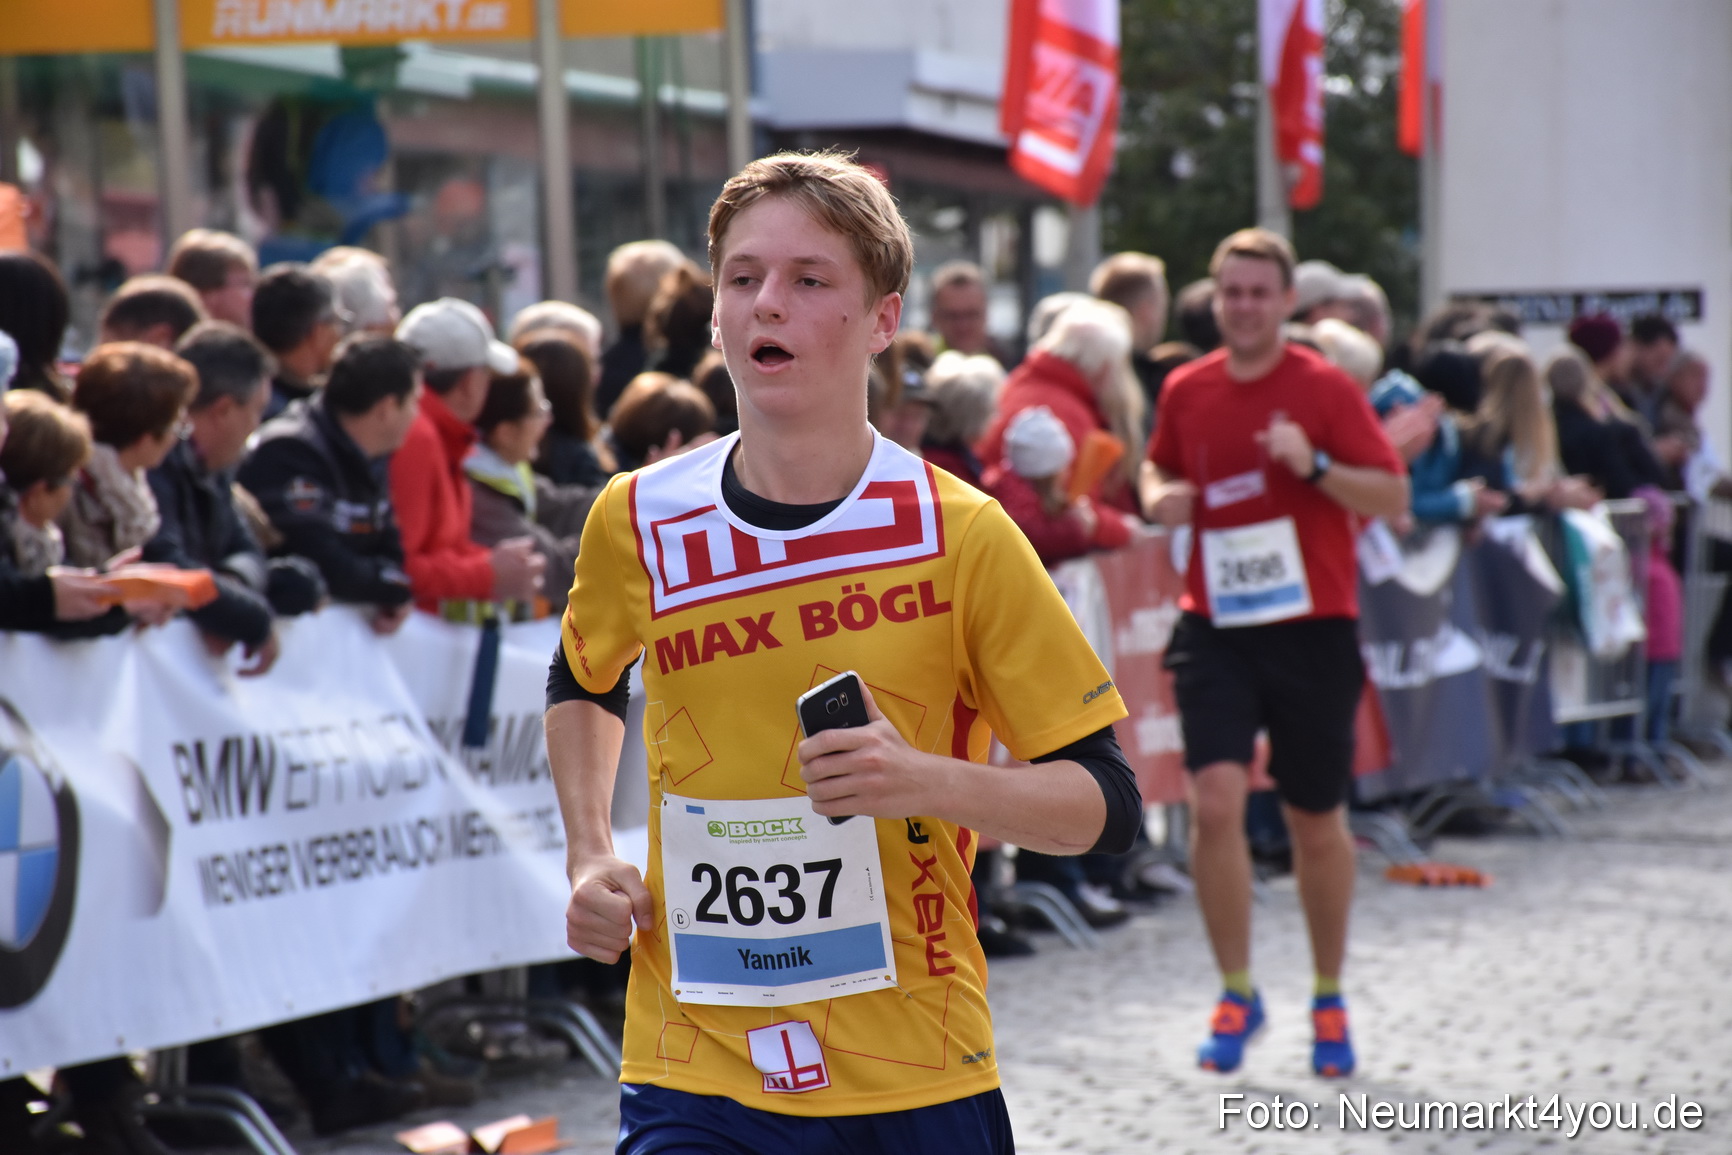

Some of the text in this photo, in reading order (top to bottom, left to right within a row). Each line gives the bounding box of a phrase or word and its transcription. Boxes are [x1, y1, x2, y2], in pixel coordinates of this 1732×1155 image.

[654, 580, 952, 676] MAX BÖGL
[173, 733, 277, 825] BMW
[727, 817, 806, 838] BOCK
[780, 834, 807, 842] concepts
[691, 858, 843, 926] 2637
[737, 946, 814, 970] Yannik
